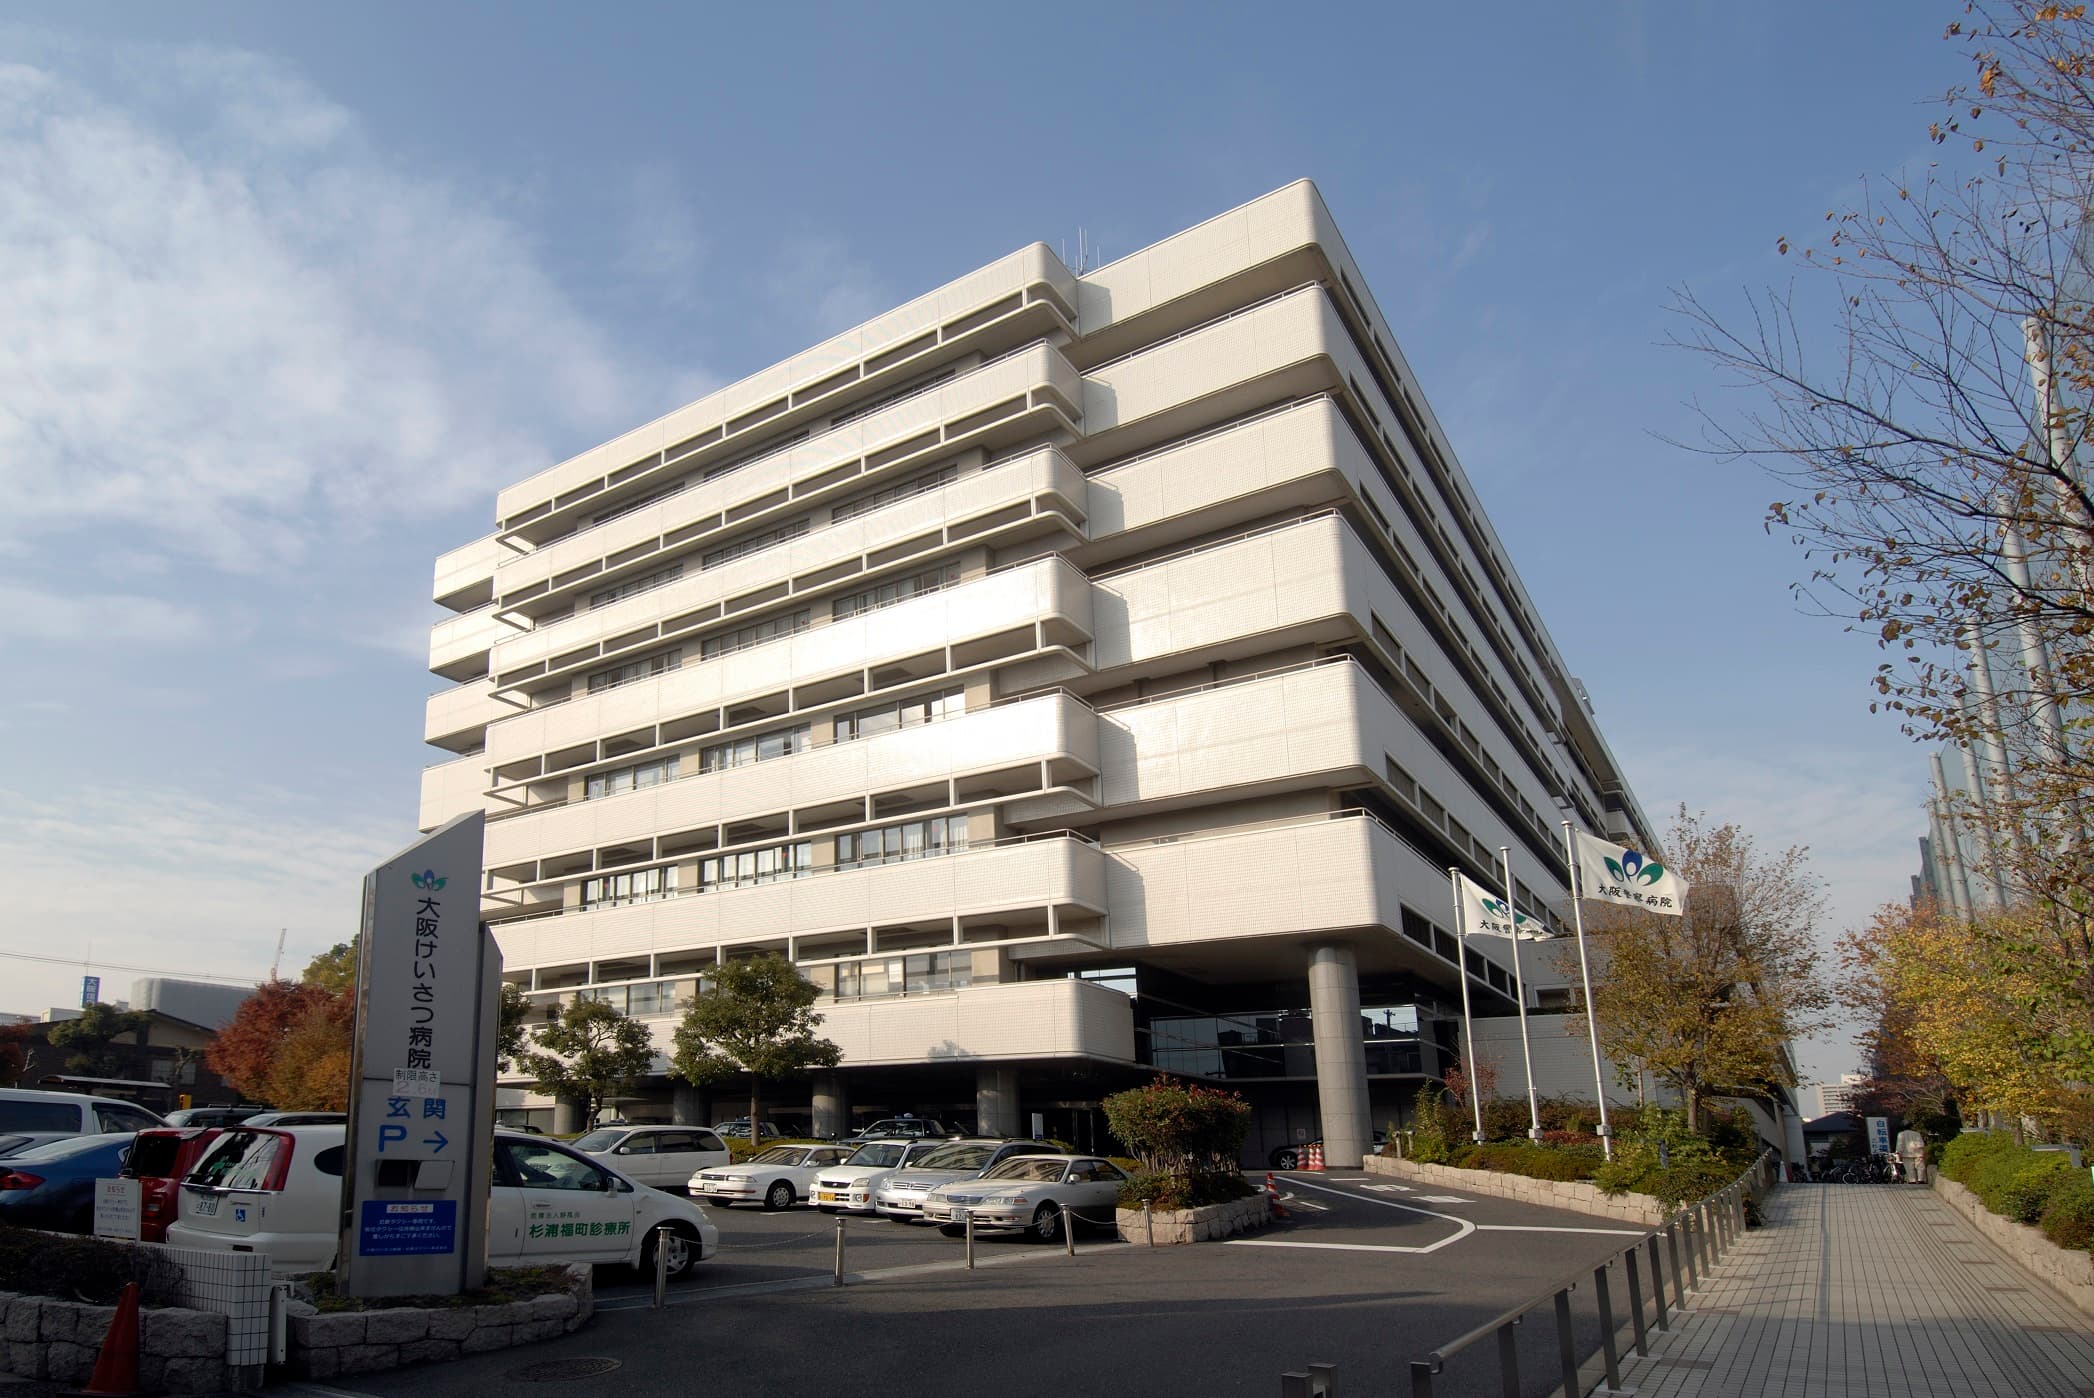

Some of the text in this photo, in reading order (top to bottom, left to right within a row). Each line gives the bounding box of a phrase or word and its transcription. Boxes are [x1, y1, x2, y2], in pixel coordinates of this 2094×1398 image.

[407, 897, 441, 1069] 大阪けいさつ病院
[395, 1069, 438, 1082] 制限高さ
[386, 1096, 446, 1119] 玄関
[378, 1125, 407, 1152] P
[529, 1221, 631, 1239] 杉浦福町診療所
